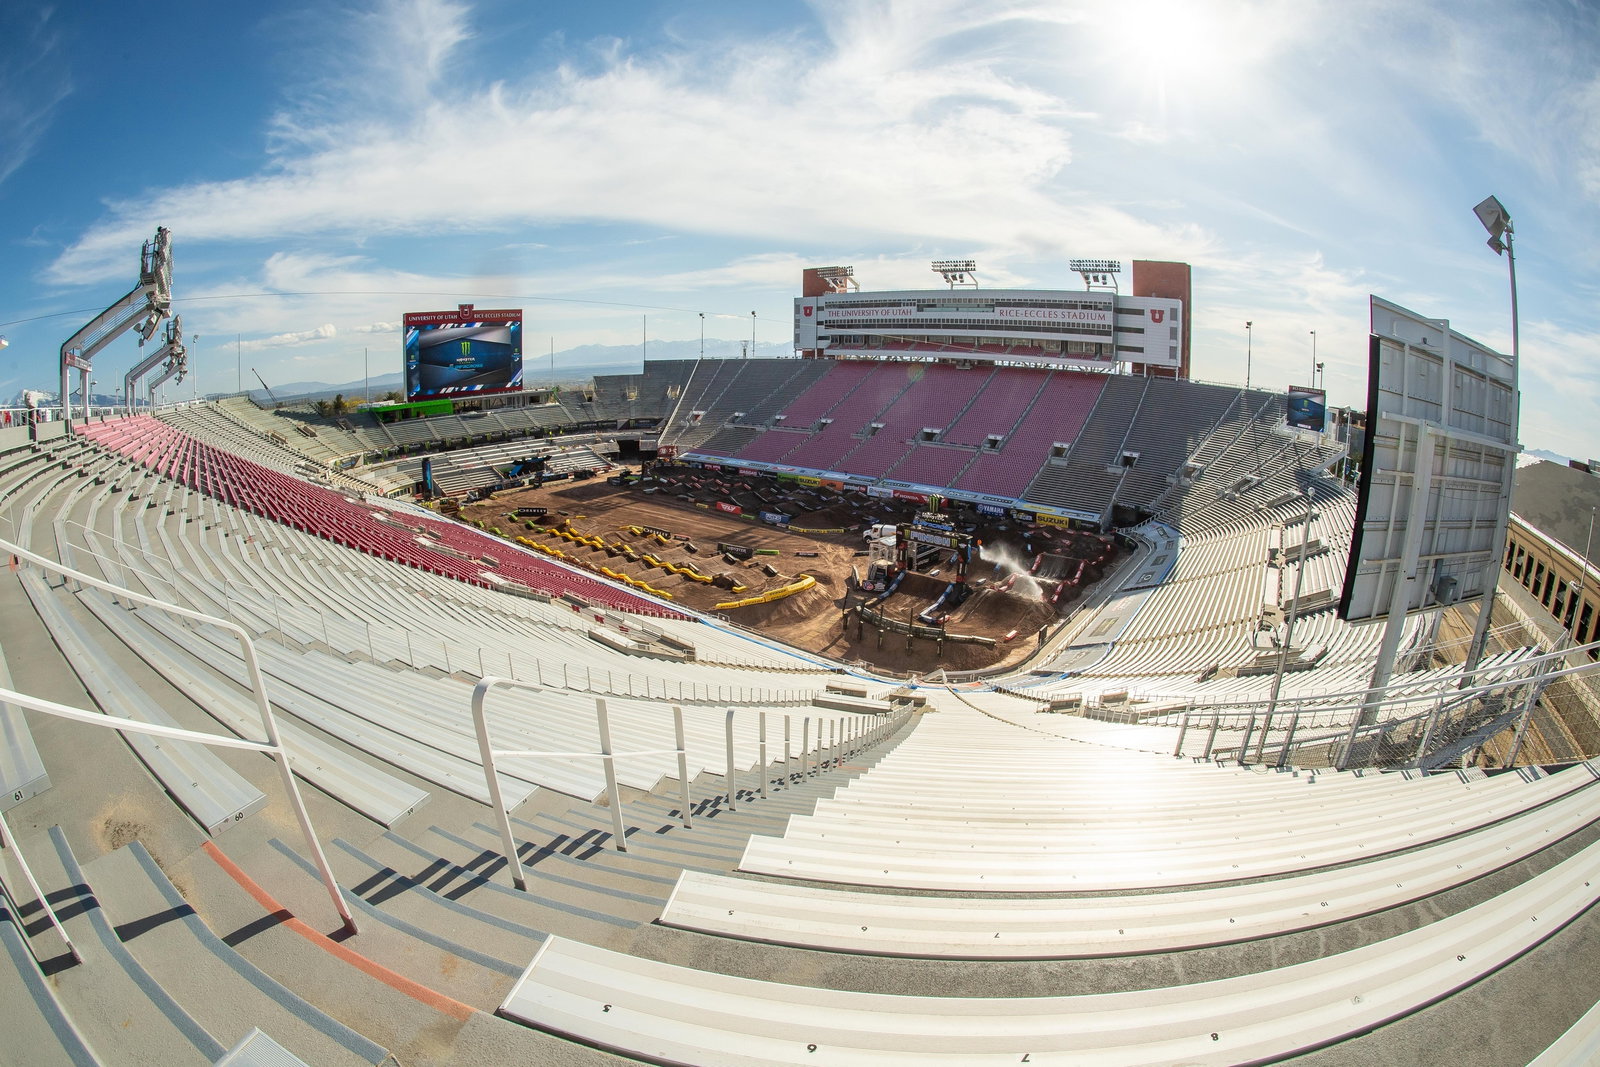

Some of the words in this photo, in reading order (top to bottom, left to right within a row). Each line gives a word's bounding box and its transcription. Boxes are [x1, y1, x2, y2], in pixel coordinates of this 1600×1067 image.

[1000, 309, 1058, 318] RICE-ECCLES
[1061, 311, 1106, 320] STADIUM
[984, 506, 1004, 514] YAMAHA
[1037, 515, 1067, 525] SUZUKI
[910, 531, 950, 547] FINISH
[14, 791, 23, 801] 61
[235, 812, 244, 821] 60
[407, 808, 414, 816] 59
[1211, 1033, 1218, 1041] 8
[1021, 1054, 1030, 1062] 7
